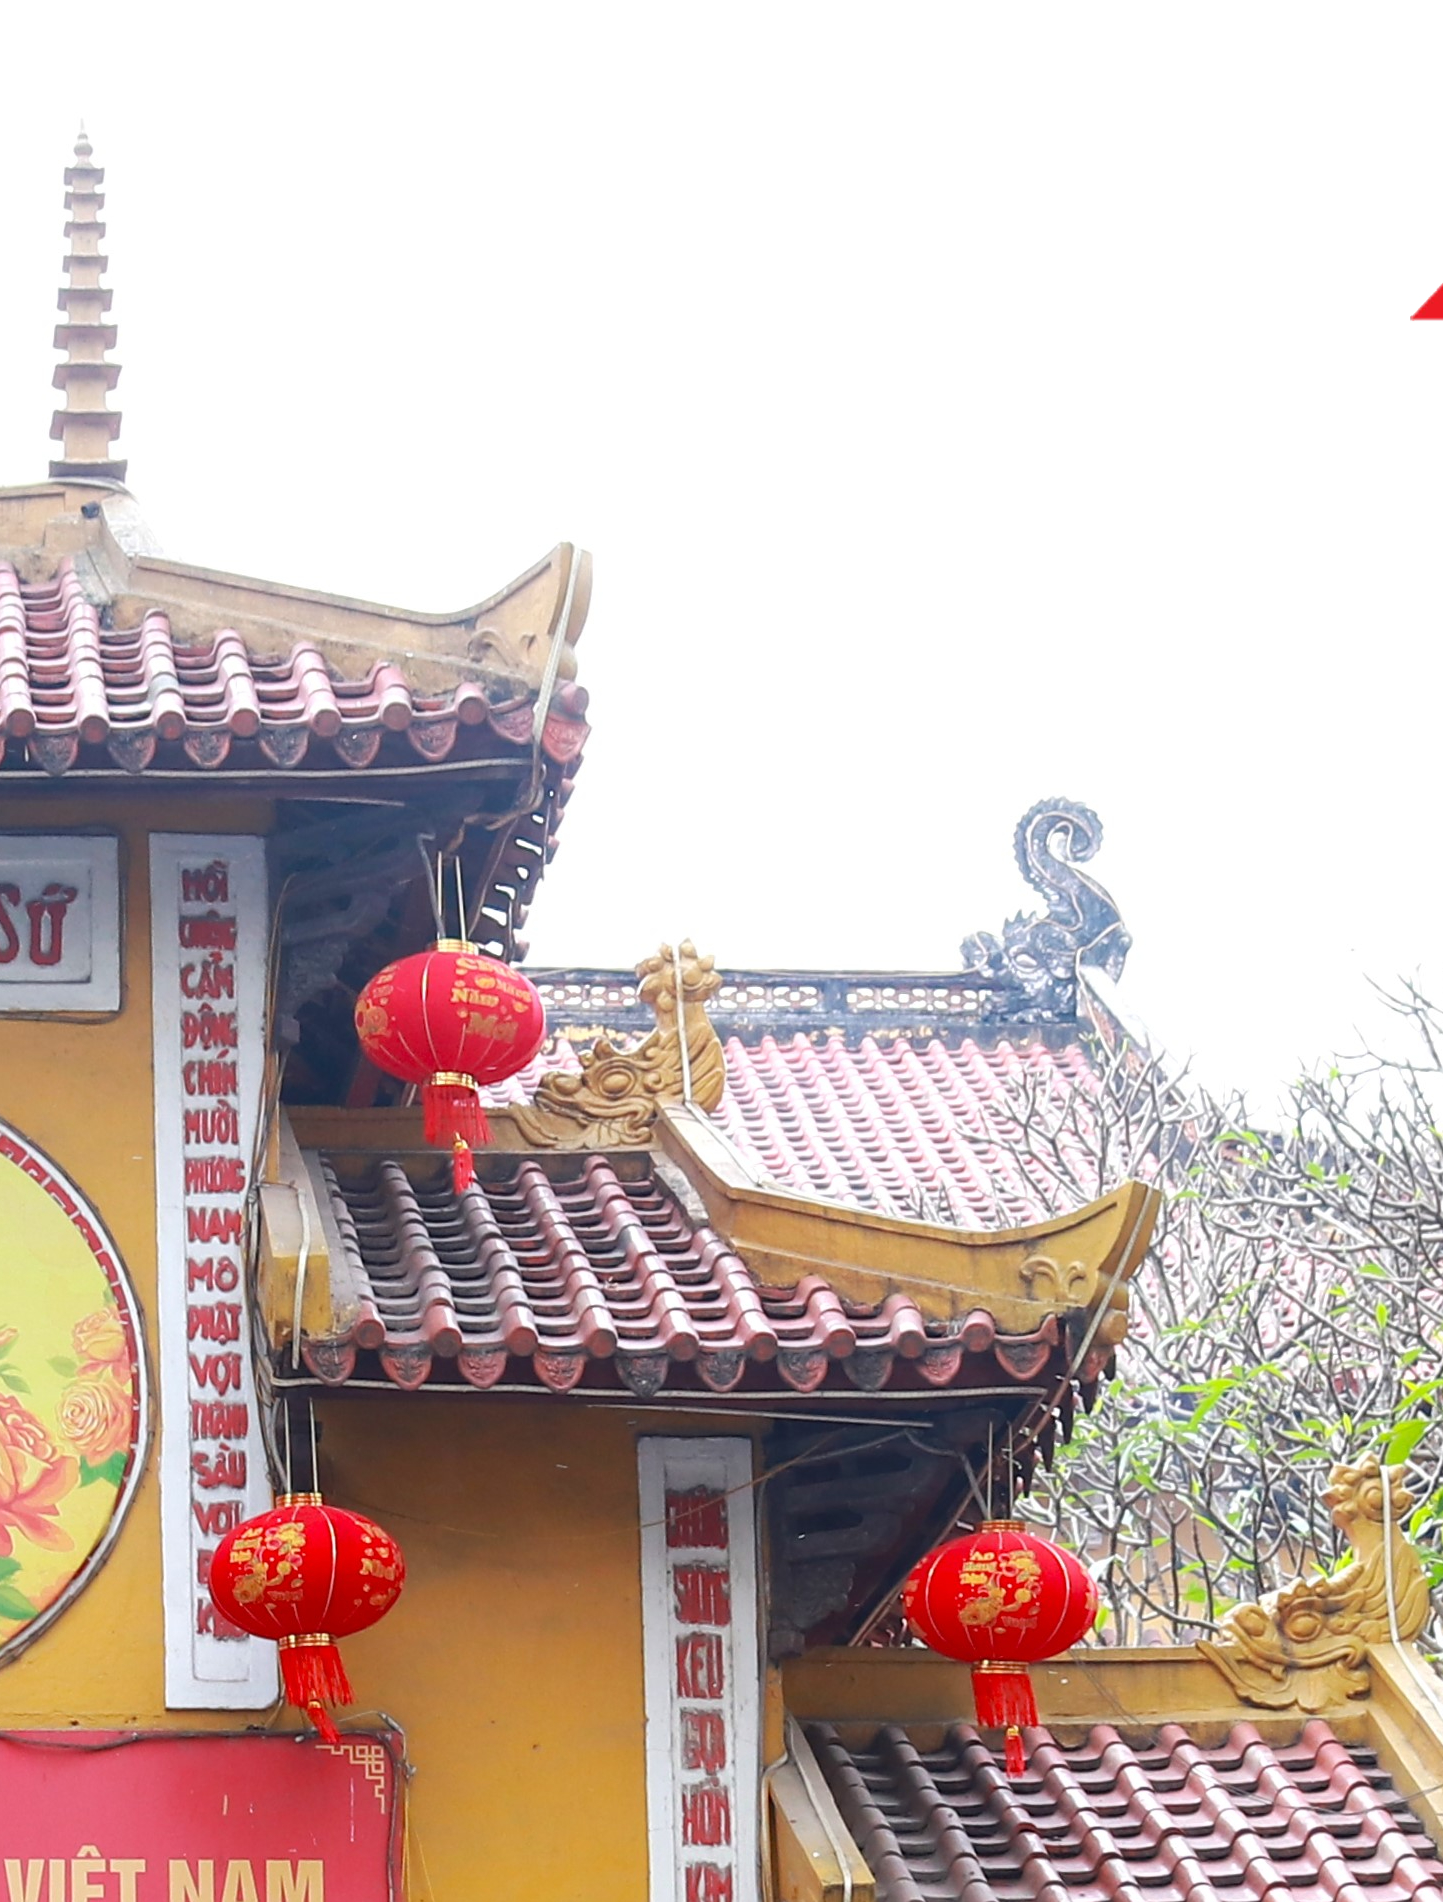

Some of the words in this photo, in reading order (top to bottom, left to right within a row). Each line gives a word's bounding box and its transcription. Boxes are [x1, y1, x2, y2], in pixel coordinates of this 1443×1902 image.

[180, 951, 234, 1000] CẢM
[181, 1002, 238, 1052] ĐỘNG
[182, 1048, 238, 1096] CHÍN
[188, 1206, 242, 1244] NAM
[188, 1256, 240, 1292] MÔ
[187, 1302, 241, 1346] PHẬT
